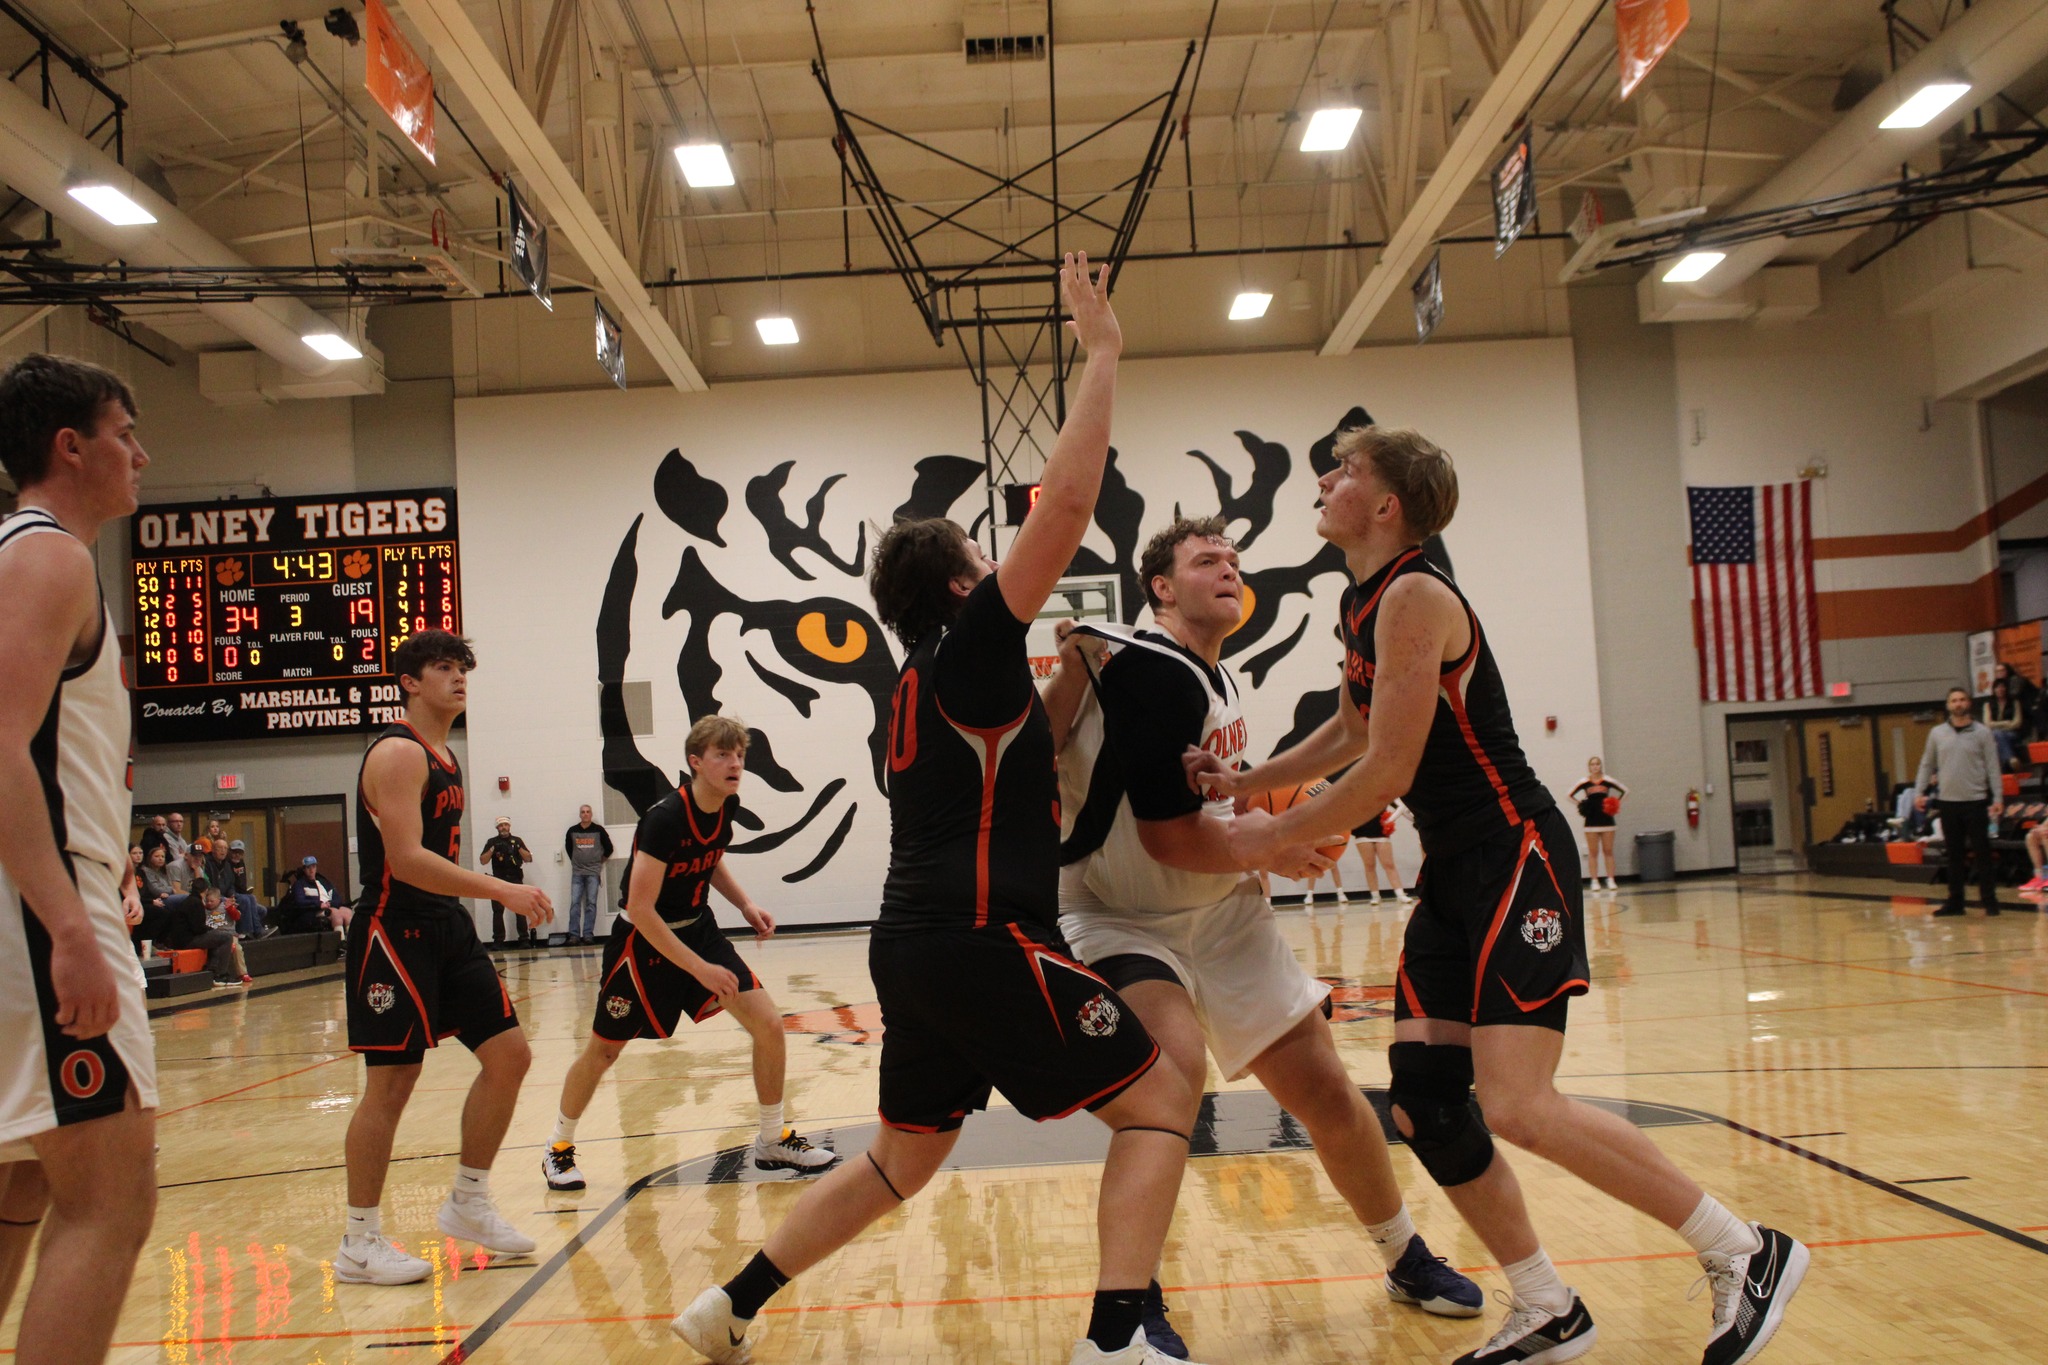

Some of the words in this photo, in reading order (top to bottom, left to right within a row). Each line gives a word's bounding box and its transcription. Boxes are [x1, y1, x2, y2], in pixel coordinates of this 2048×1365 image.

[139, 506, 275, 548] OLNEY
[296, 497, 447, 539] TIGERS
[384, 548, 405, 561] PLY
[412, 547, 426, 560] FL
[429, 545, 451, 559] PTS
[136, 562, 157, 575] PLY
[163, 561, 177, 574] FL
[181, 559, 203, 573] PTS
[273, 552, 332, 580] 4:43
[402, 564, 407, 577] 1
[418, 563, 423, 576] 1
[440, 561, 450, 574] 4
[138, 577, 159, 593] 50
[170, 577, 175, 590] 1
[186, 576, 202, 589] 11
[332, 582, 372, 597] GUEST
[397, 581, 408, 597] 2
[419, 581, 424, 594] 1
[442, 579, 451, 594] 3
[138, 595, 159, 611] 54
[165, 594, 175, 609] 2
[192, 593, 202, 608] 5
[219, 589, 255, 603] HOME
[280, 593, 310, 603] PERIOD
[350, 599, 373, 624] 19
[399, 600, 408, 613] 4
[420, 599, 425, 612] 1
[442, 597, 451, 612] 6
[145, 613, 160, 628] 12
[165, 612, 176, 628] 0
[193, 611, 203, 626] 2
[226, 606, 258, 633] 34
[290, 605, 301, 627] 3
[399, 617, 409, 633] 5
[415, 616, 425, 631] 0
[442, 615, 452, 630] 0
[145, 631, 160, 647] 10
[171, 631, 176, 644] 1
[188, 629, 203, 644] 10
[214, 636, 242, 646] FOULS
[270, 632, 302, 643] PLAYER
[303, 631, 325, 641] FOUL
[351, 628, 378, 638] FOULS
[247, 641, 263, 649] T.O.L.
[362, 638, 374, 660] 2
[390, 635, 409, 652] 3
[146, 650, 161, 664] 14
[167, 648, 177, 664] 0
[194, 647, 204, 662] 6
[224, 646, 238, 668] 0
[250, 649, 260, 665] 0
[333, 644, 343, 661] 0
[167, 666, 177, 682] 0
[215, 671, 243, 681] SCORE
[282, 667, 312, 678] MATCH
[352, 664, 380, 674] SCORE
[240, 688, 340, 709] MARSHALL
[349, 687, 361, 703] &
[143, 702, 206, 718] Donated
[212, 699, 234, 717] By
[266, 708, 361, 730] PROVINES
[368, 706, 406, 724] TRU
[221, 776, 236, 788] EXIT
